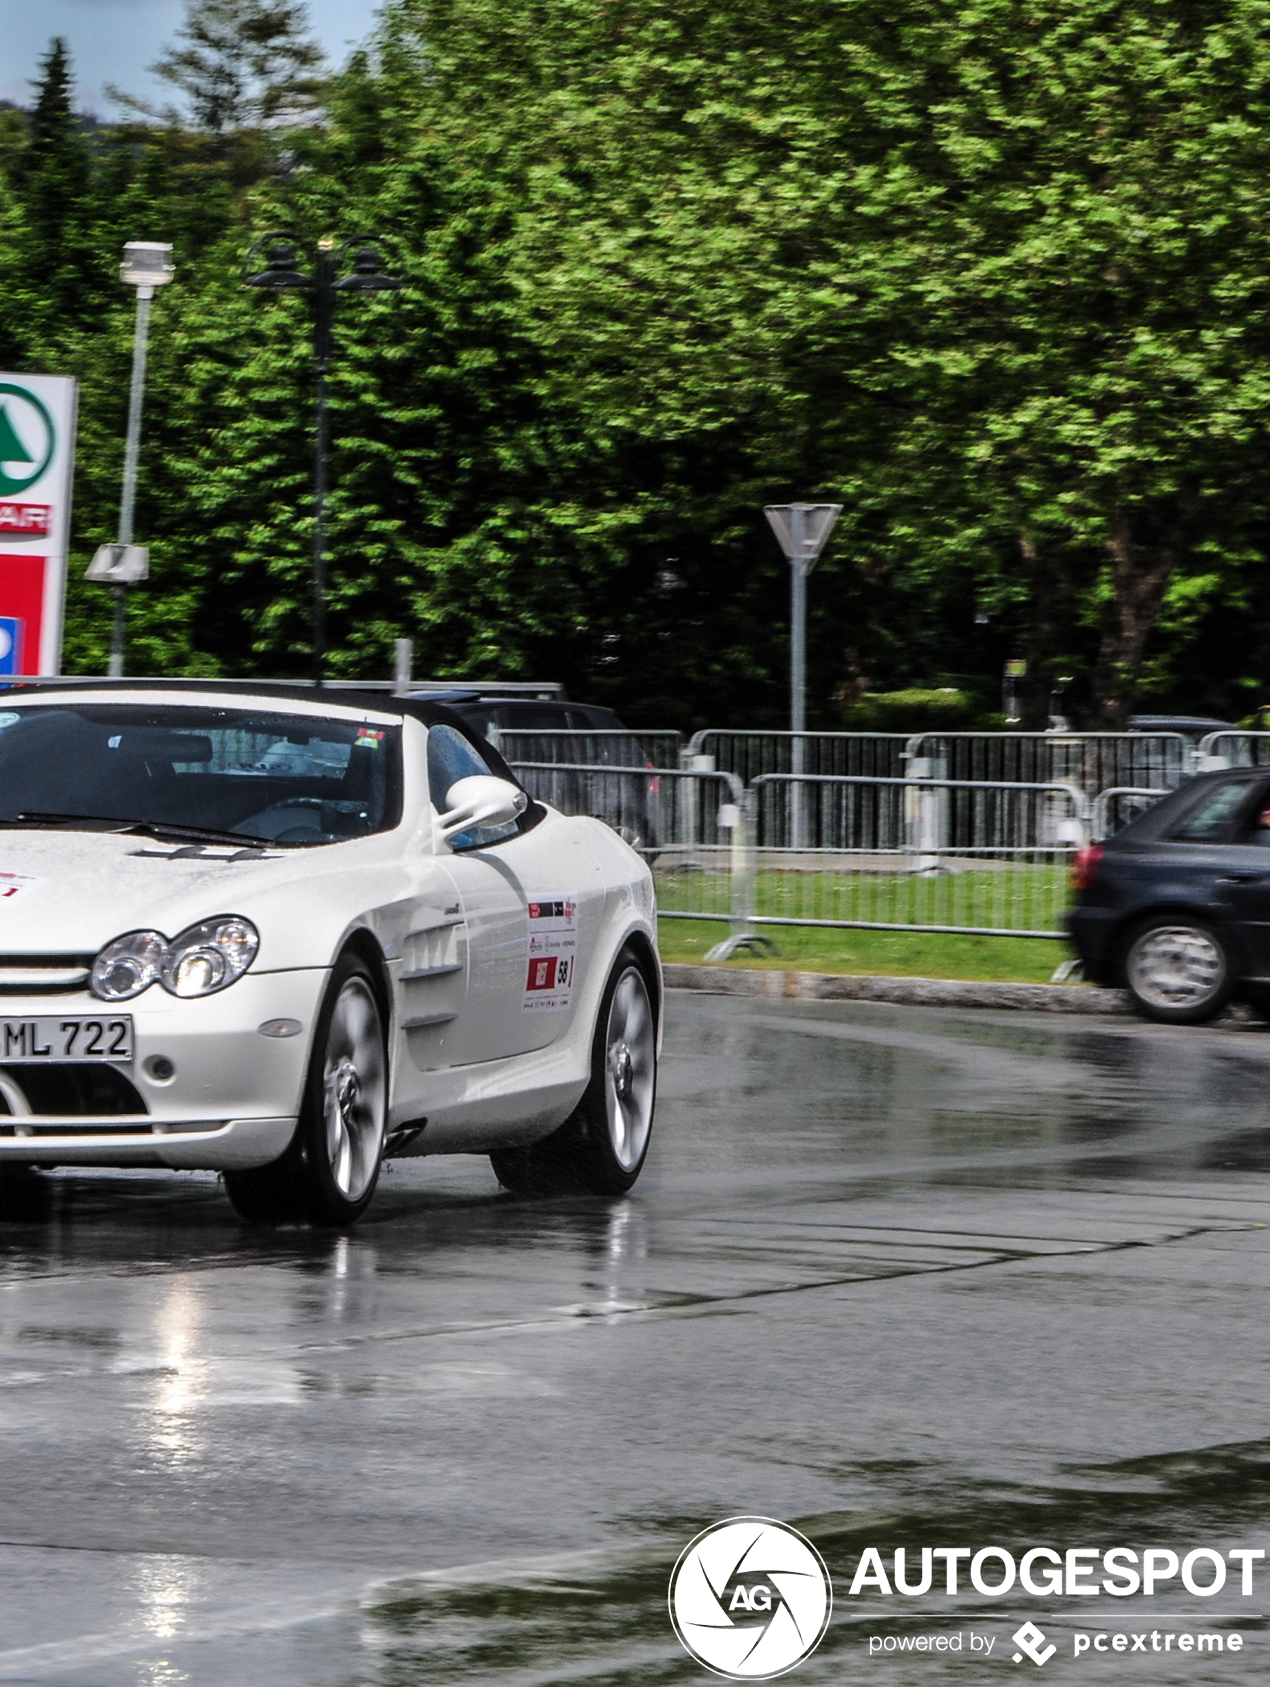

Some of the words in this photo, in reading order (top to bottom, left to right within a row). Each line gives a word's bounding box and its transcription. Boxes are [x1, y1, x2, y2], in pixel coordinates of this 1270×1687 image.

[557, 960, 569, 985] 58
[4, 1022, 53, 1056] ML
[61, 1020, 129, 1056] 722
